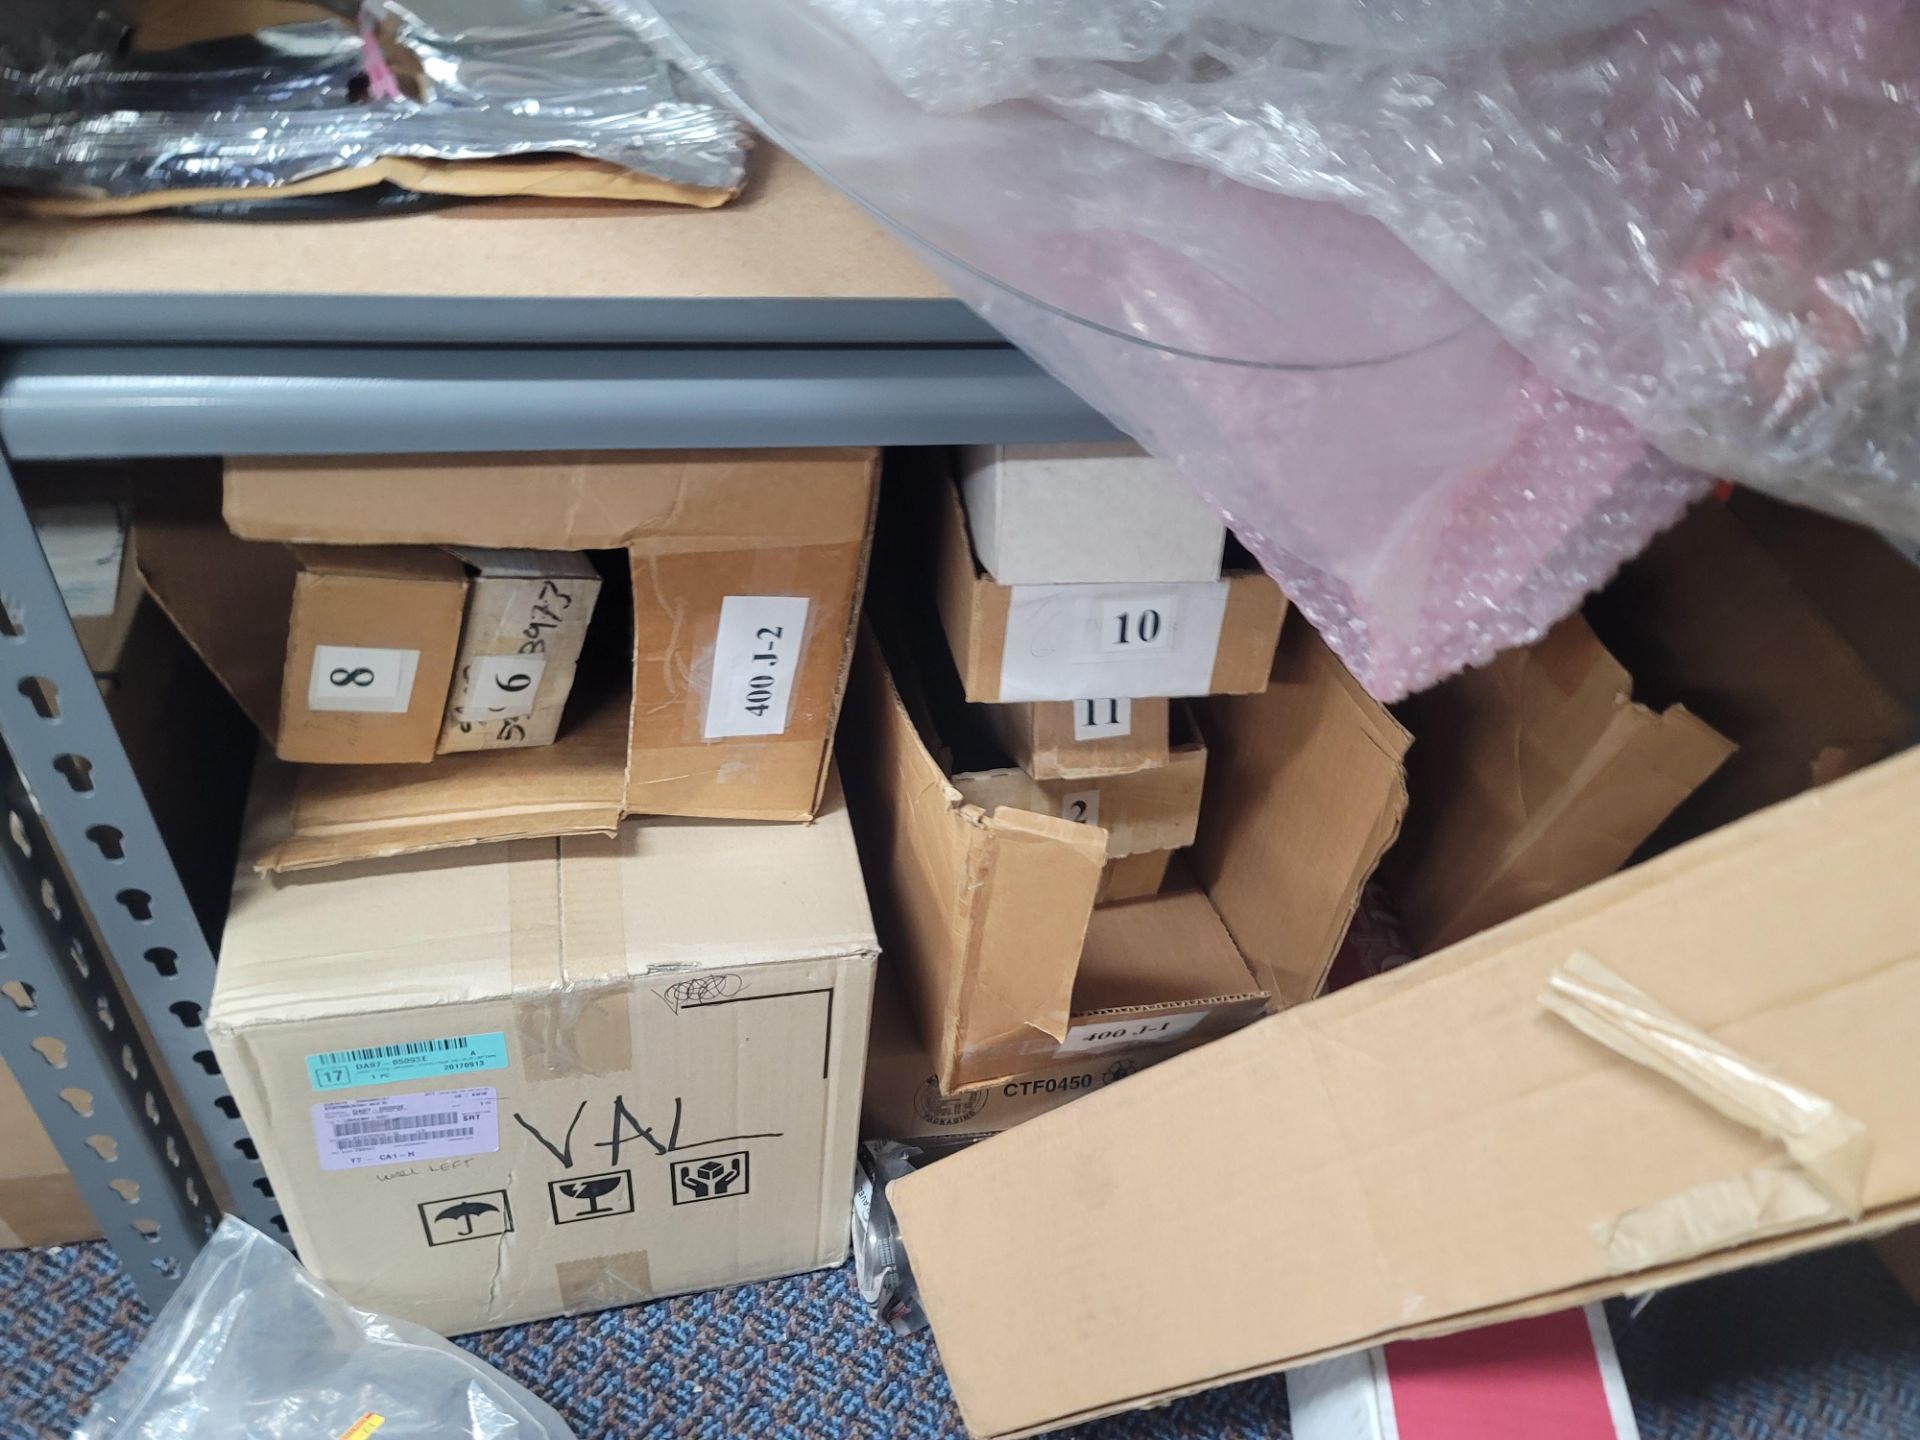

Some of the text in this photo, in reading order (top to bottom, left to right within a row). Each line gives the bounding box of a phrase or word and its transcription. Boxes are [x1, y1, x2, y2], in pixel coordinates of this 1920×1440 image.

[1112, 609, 1161, 645] 10
[329, 667, 375, 687] 8
[495, 673, 532, 692] 6
[744, 626, 784, 717] 400 J-2
[1082, 698, 1121, 727] 11
[1070, 800, 1088, 824] 2
[1082, 1021, 1171, 1042] 400 J-1
[324, 1070, 343, 1083] 17
[1003, 1073, 1093, 1098] CTF0450
[513, 1095, 784, 1169] VAL
